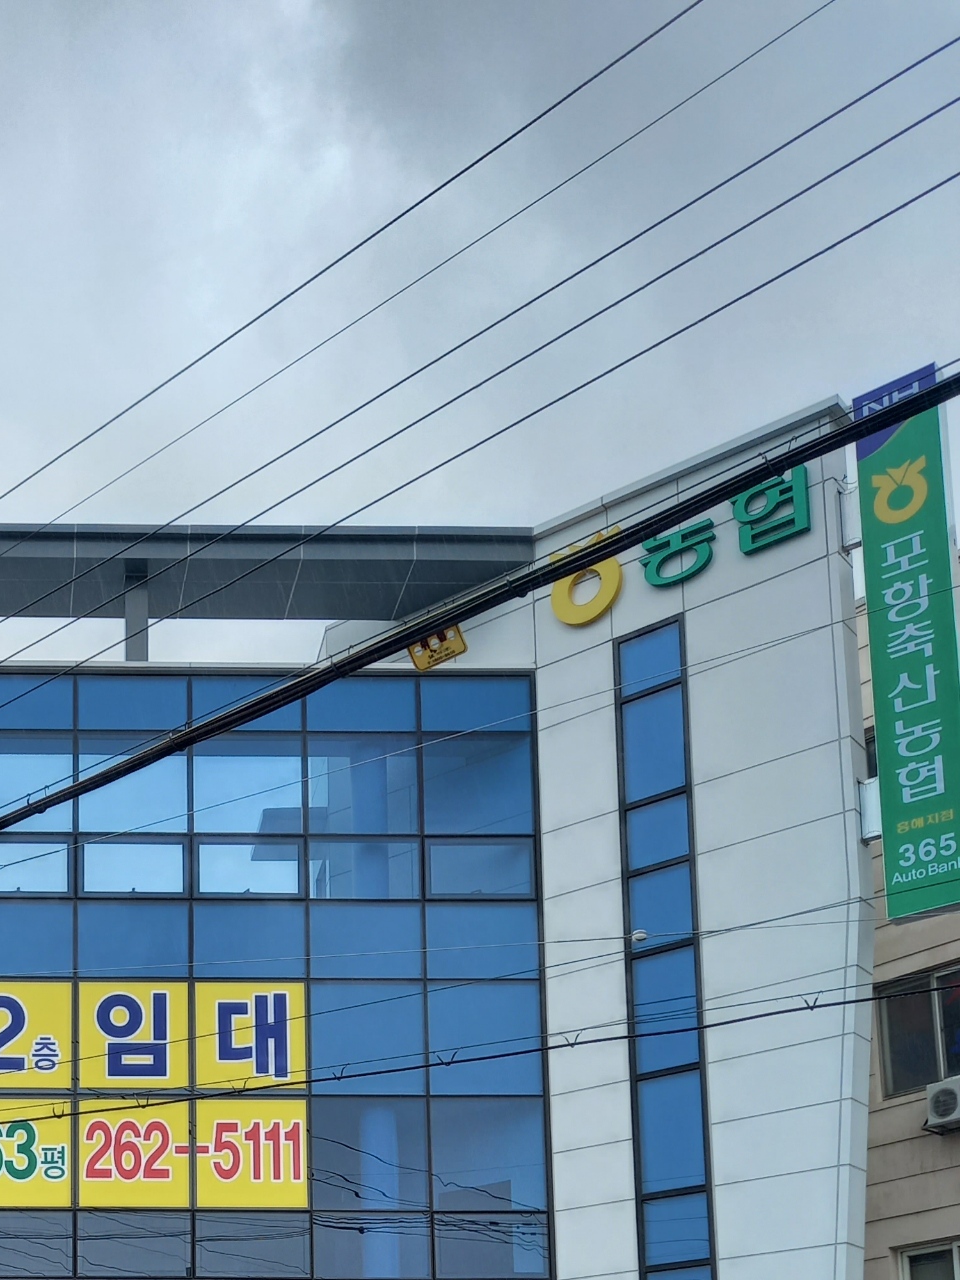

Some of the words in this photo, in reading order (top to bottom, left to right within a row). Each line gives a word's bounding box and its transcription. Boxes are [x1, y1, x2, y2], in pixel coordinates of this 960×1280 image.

[638, 463, 811, 588] 농협
[880, 529, 946, 804] 포항축산농협
[898, 832, 957, 867] 365
[82, 1118, 304, 1184] 262-5111
